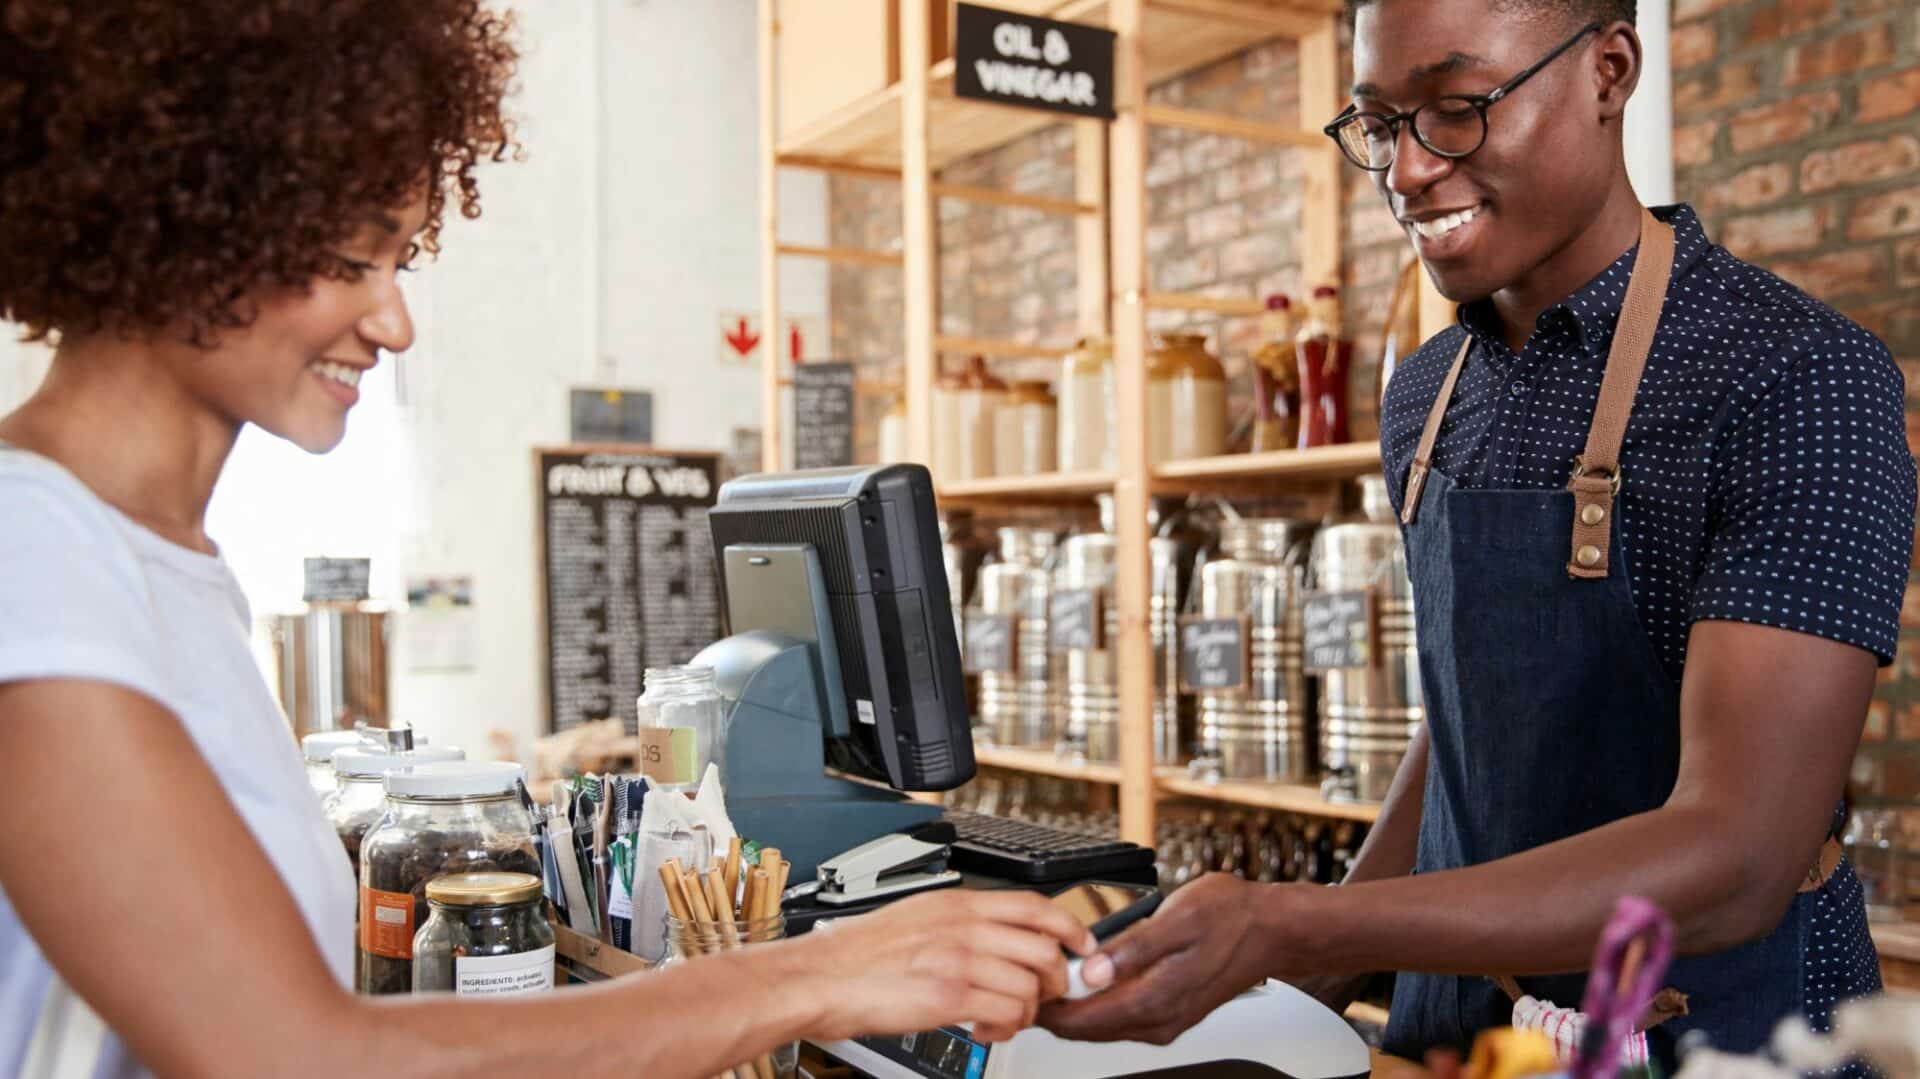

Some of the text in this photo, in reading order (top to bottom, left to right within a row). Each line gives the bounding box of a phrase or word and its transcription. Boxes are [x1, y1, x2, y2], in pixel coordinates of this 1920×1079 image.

[993, 22, 1071, 65] OIL &
[974, 58, 1097, 107] VINEGAR
[548, 464, 626, 496] FRUIT
[625, 464, 654, 497] &
